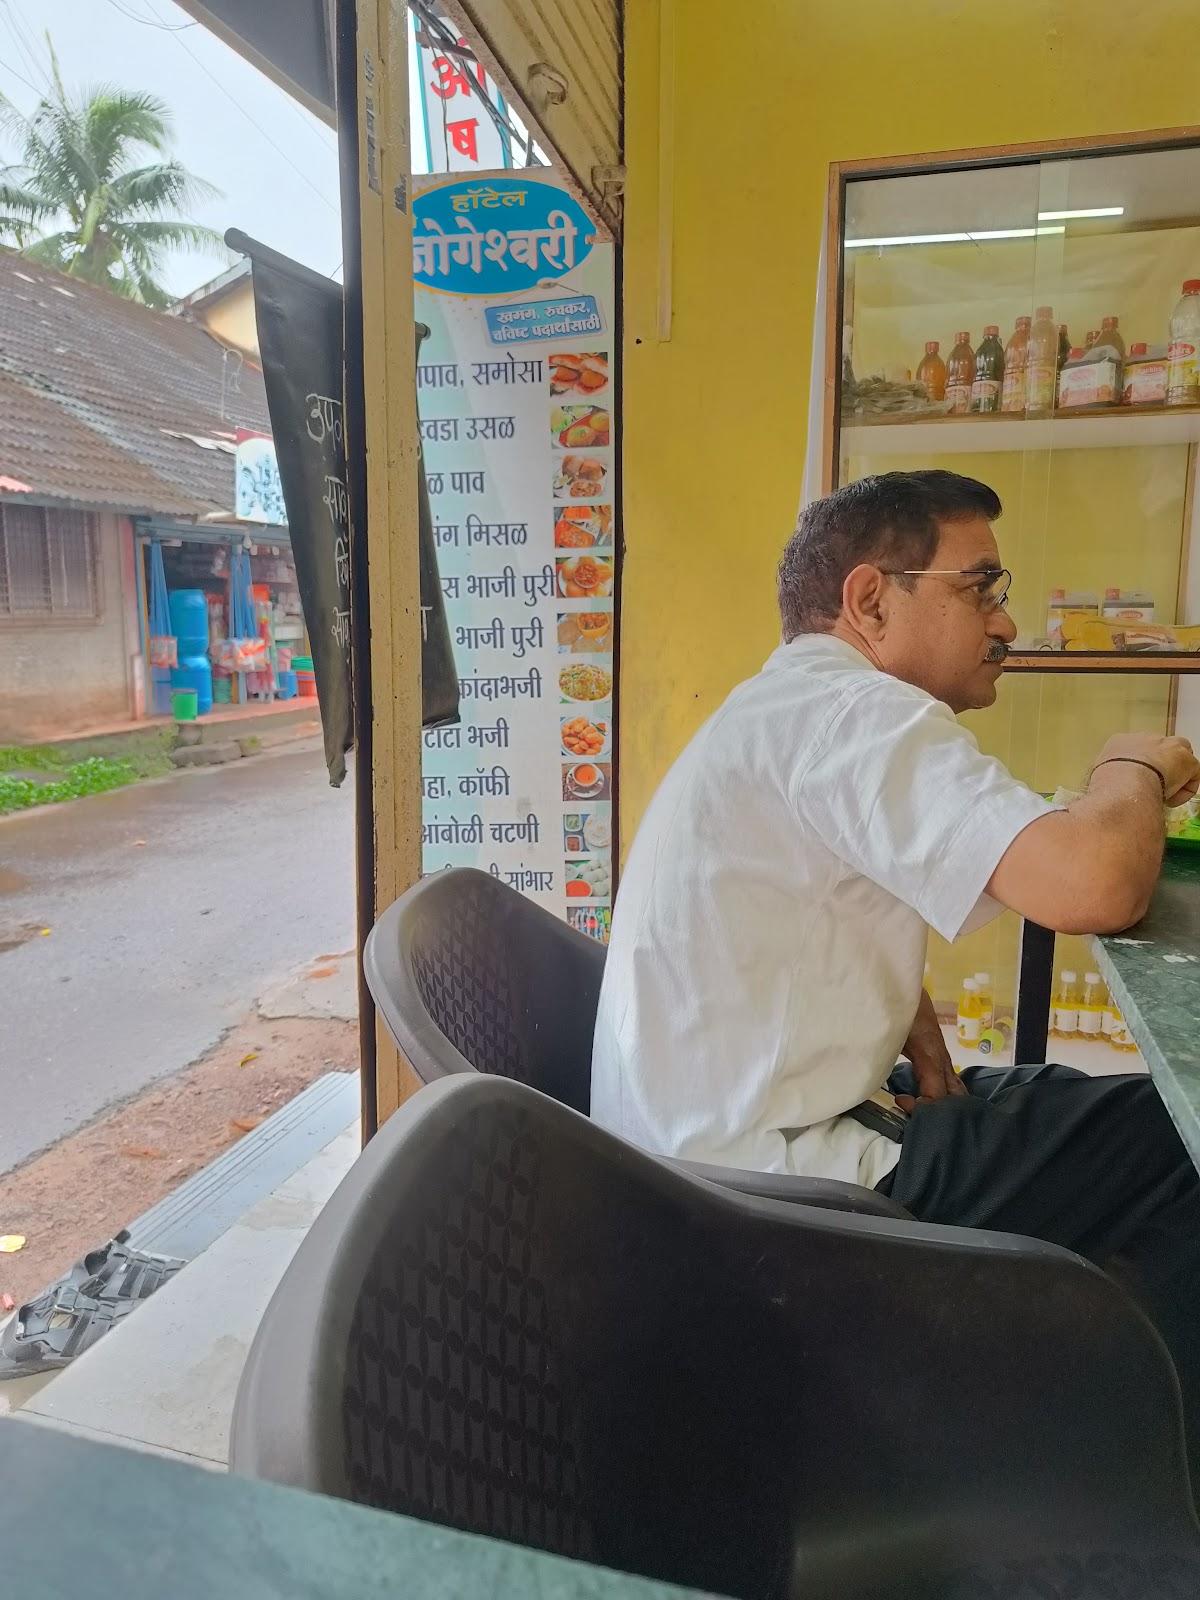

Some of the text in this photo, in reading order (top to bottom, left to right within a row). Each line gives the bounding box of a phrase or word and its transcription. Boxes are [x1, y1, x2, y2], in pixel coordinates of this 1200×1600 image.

[450, 187, 528, 212] हॉटेल
[472, 352, 543, 385] समोसा
[466, 416, 515, 440] उसळ
[450, 471, 485, 494] पाव
[466, 514, 528, 546] मिसळ
[467, 566, 516, 598] भाजी
[523, 564, 557, 607] पुरी
[456, 617, 504, 649] भाजी
[511, 616, 544, 657] पुरी
[468, 717, 509, 748] भजी
[458, 766, 510, 796] कॉफी
[490, 813, 540, 843] चटणी
[505, 863, 554, 892] सांभार
